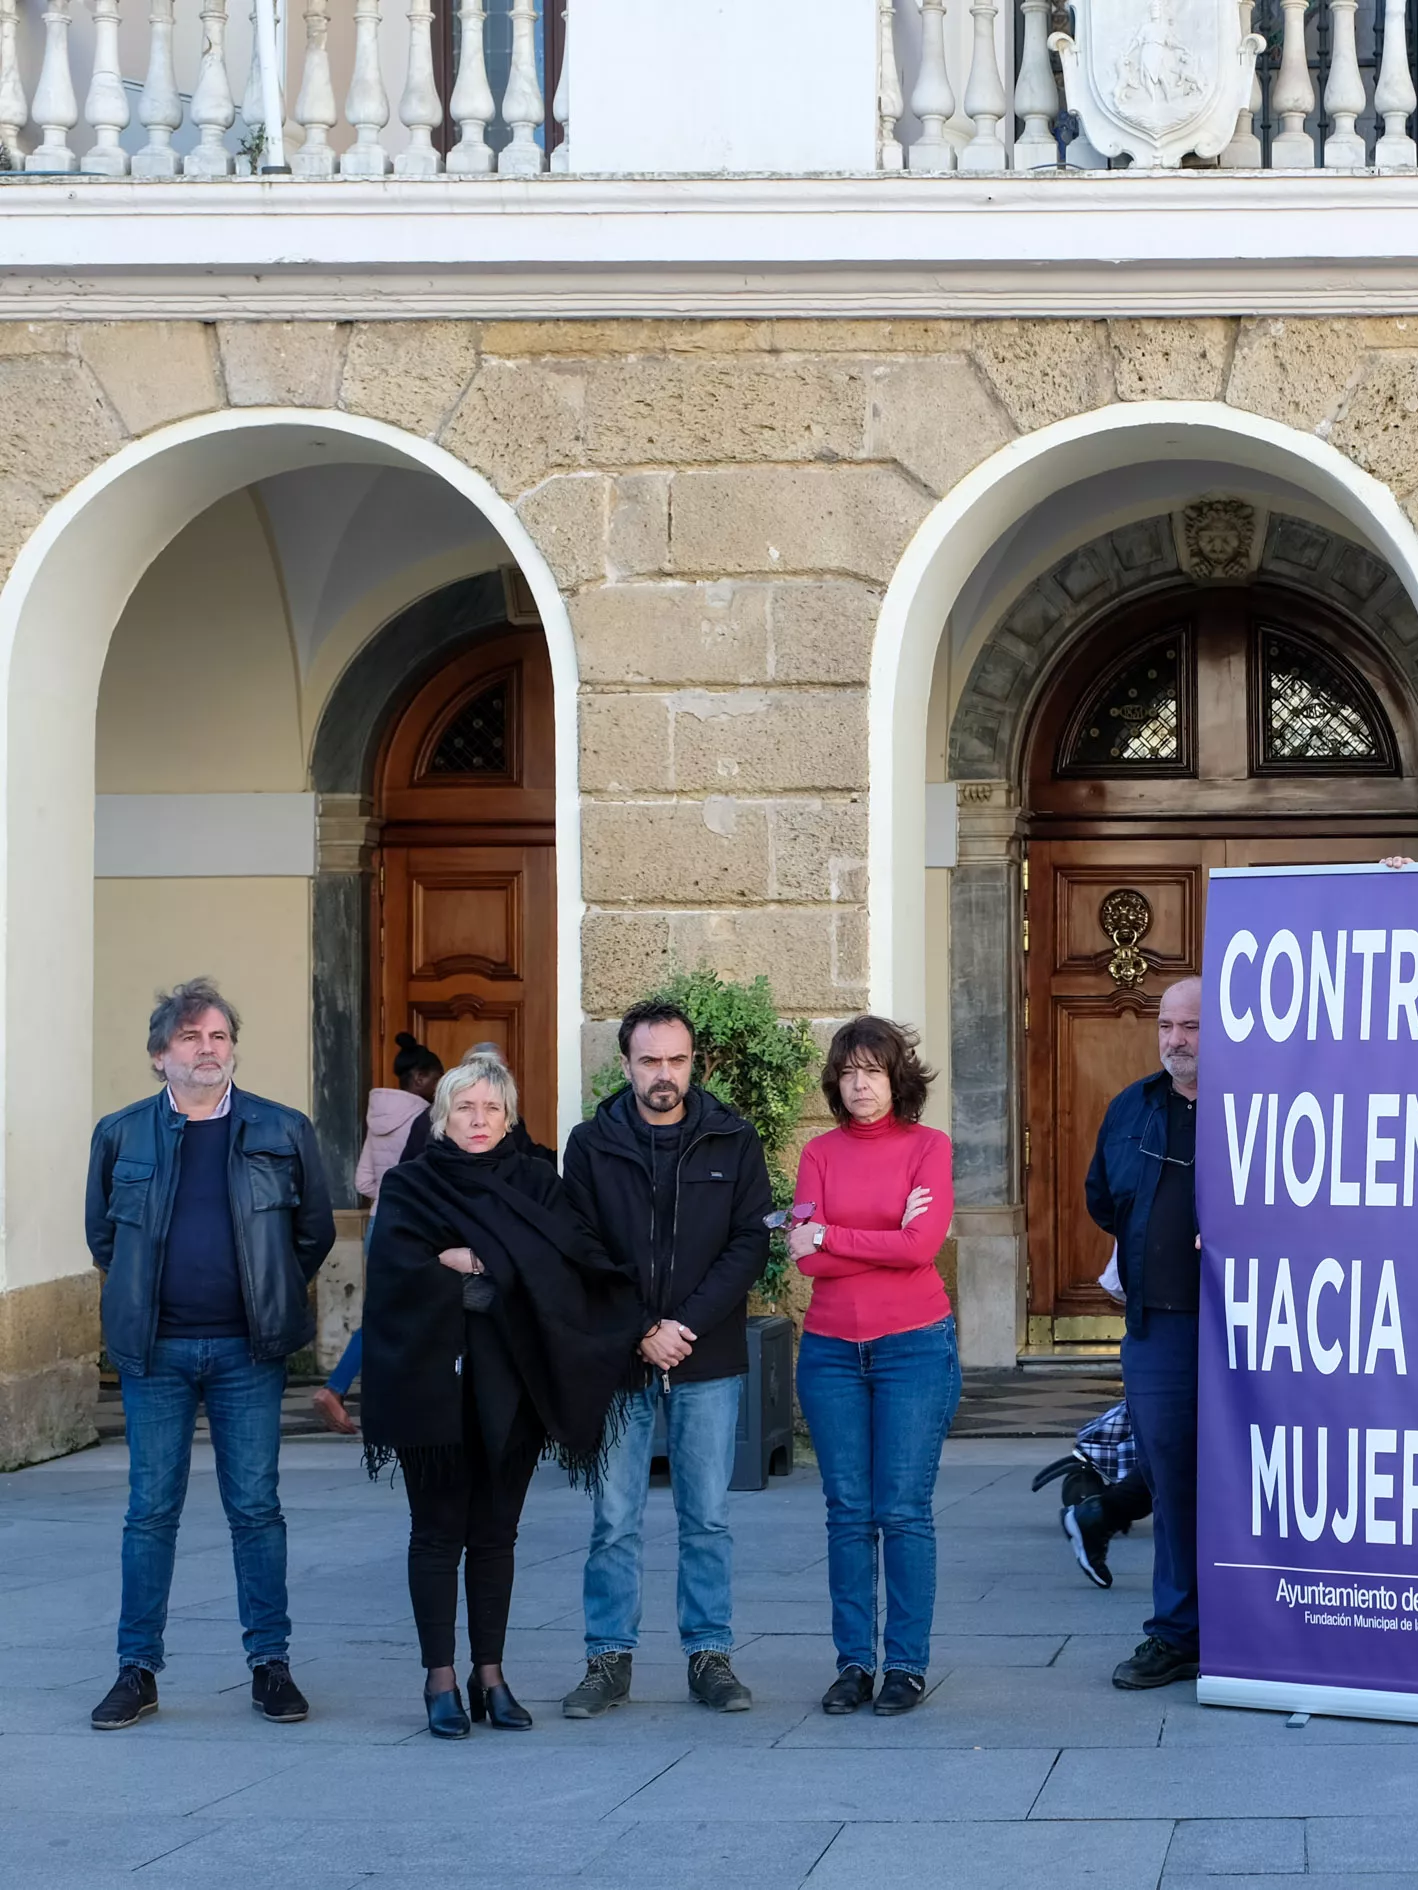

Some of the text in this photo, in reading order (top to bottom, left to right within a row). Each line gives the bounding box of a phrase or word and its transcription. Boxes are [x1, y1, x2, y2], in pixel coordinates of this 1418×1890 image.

[1224, 1257, 1408, 1376] HACIA
[1275, 1577, 1398, 1612] Ayuntamiento
[1304, 1610, 1352, 1627] Fundación
[1353, 1614, 1399, 1632] Municipal
[1400, 1617, 1413, 1631] de
